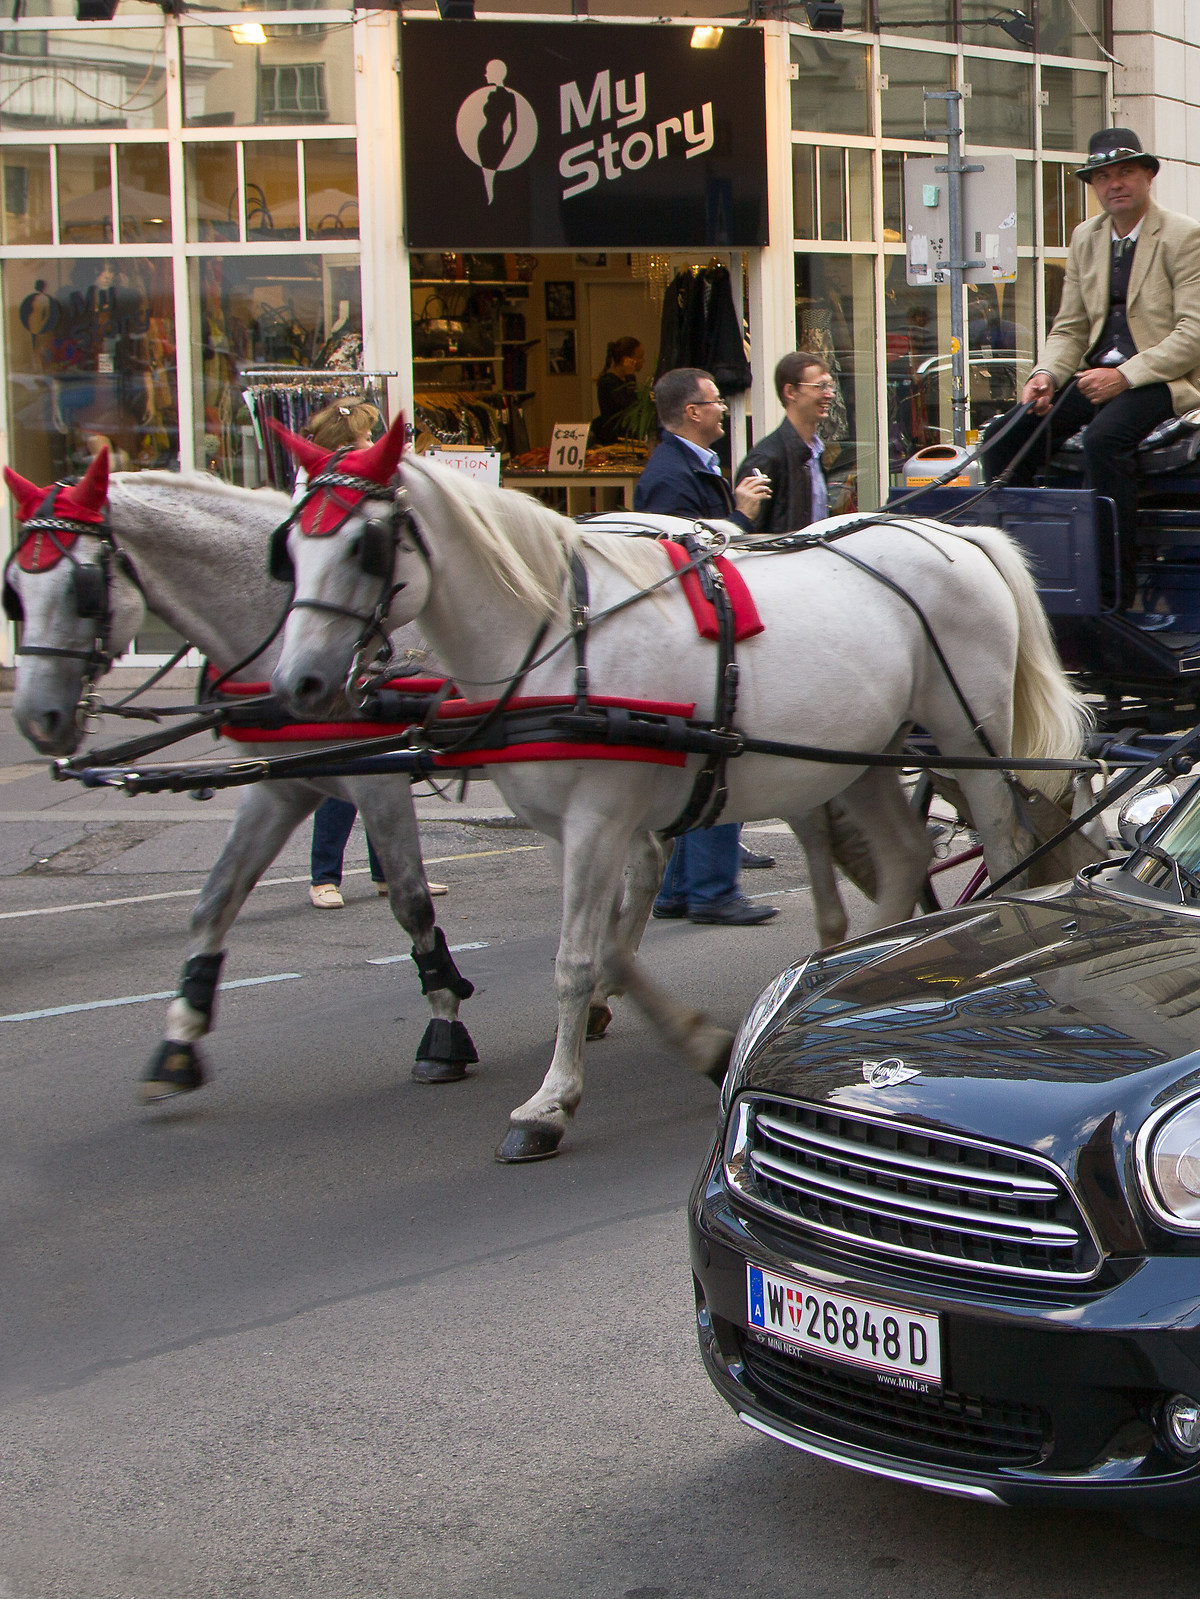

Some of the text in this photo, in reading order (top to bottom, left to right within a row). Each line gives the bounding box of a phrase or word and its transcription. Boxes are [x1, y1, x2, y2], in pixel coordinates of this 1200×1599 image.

[559, 69, 647, 135] My
[558, 101, 715, 200] Story
[754, 1303, 762, 1318] A
[767, 1281, 784, 1327] W
[767, 1336, 783, 1351] MINI
[877, 1374, 929, 1393] www.MINI.at
